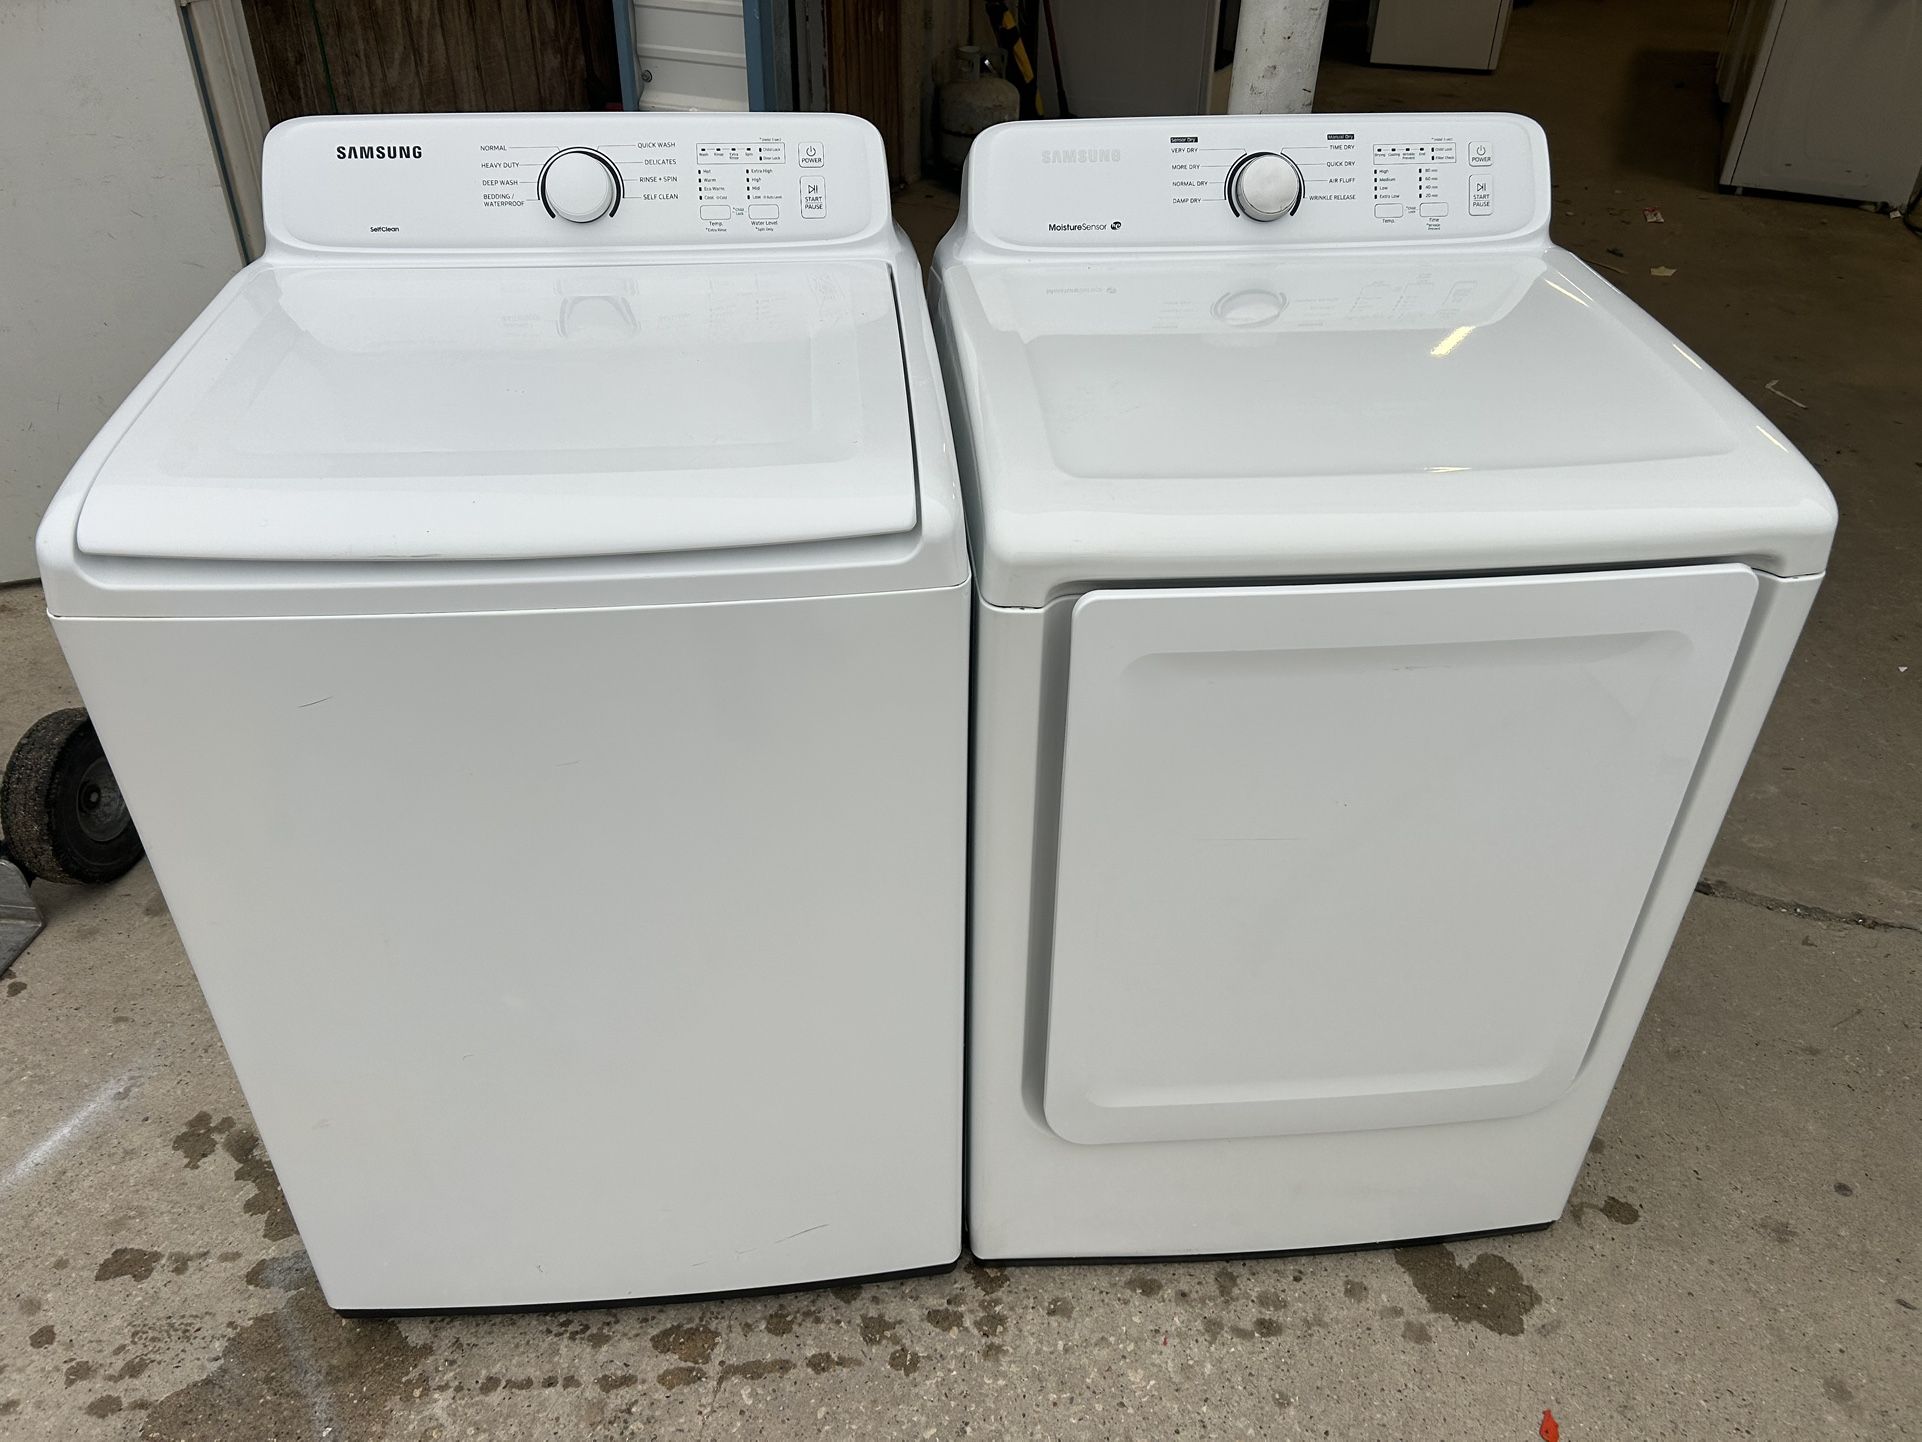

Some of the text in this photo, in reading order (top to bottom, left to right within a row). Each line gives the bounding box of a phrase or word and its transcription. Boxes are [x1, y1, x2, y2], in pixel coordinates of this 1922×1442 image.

[336, 146, 422, 159] SAMSUNG
[1042, 149, 1121, 164] SAMSUNG
[1048, 222, 1107, 232] MoistureSensor
